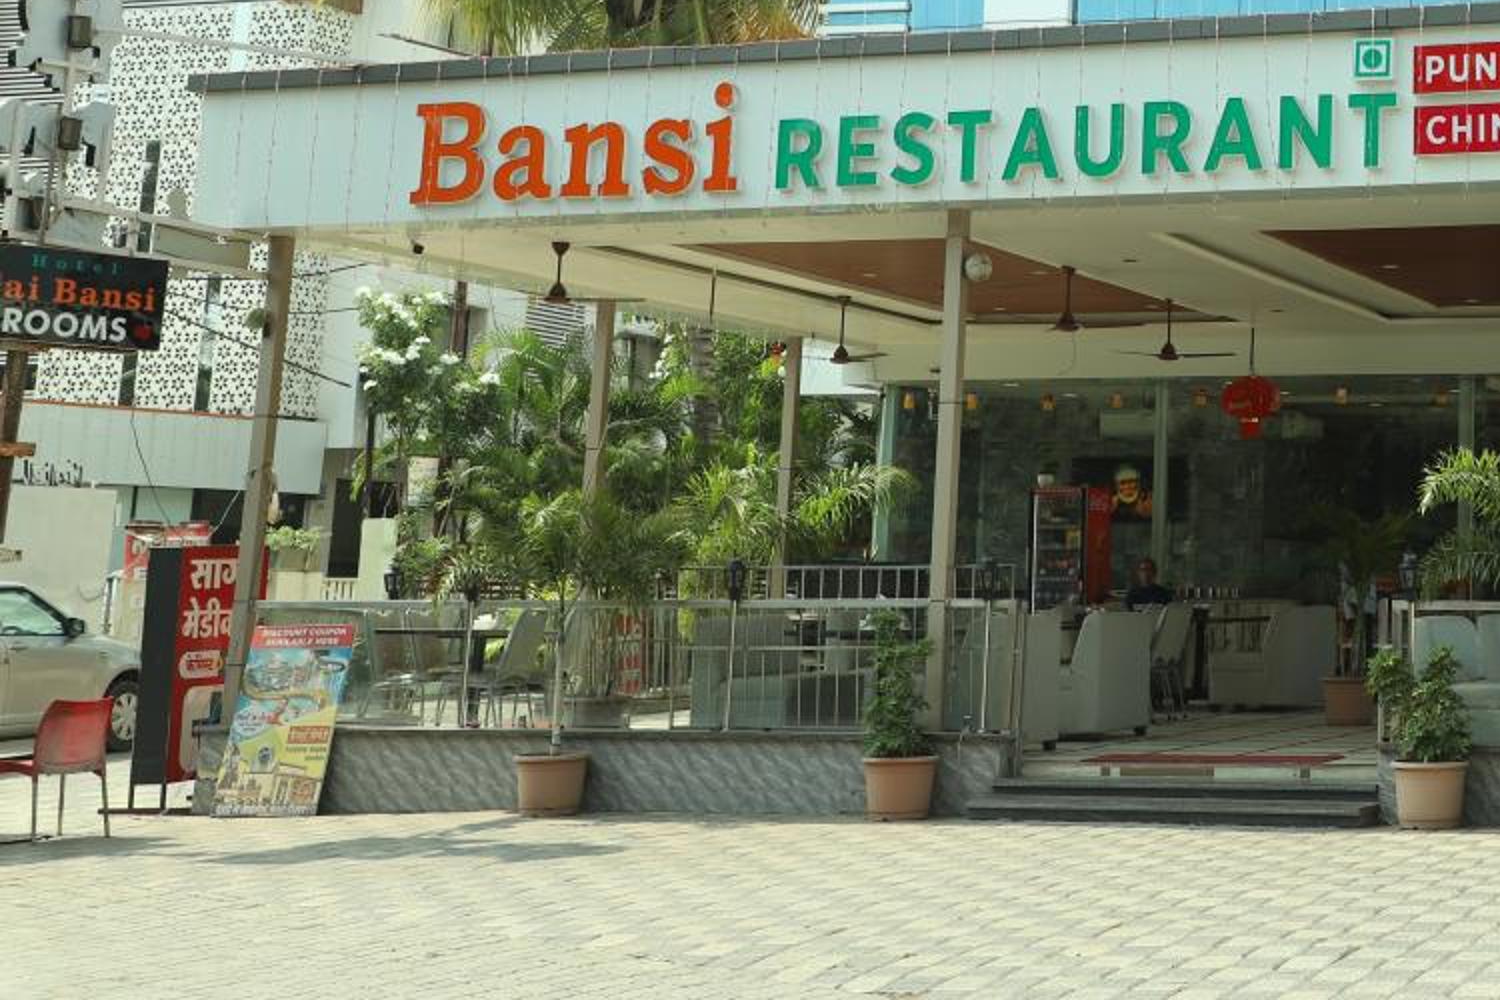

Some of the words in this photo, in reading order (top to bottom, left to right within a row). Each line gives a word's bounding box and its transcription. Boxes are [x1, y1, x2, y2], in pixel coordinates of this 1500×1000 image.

[409, 81, 739, 205] Bansi
[774, 91, 1398, 190] RESTAURANT
[0, 274, 40, 301] ai
[53, 277, 156, 312] Bansi
[1, 307, 127, 342] ROOMS
